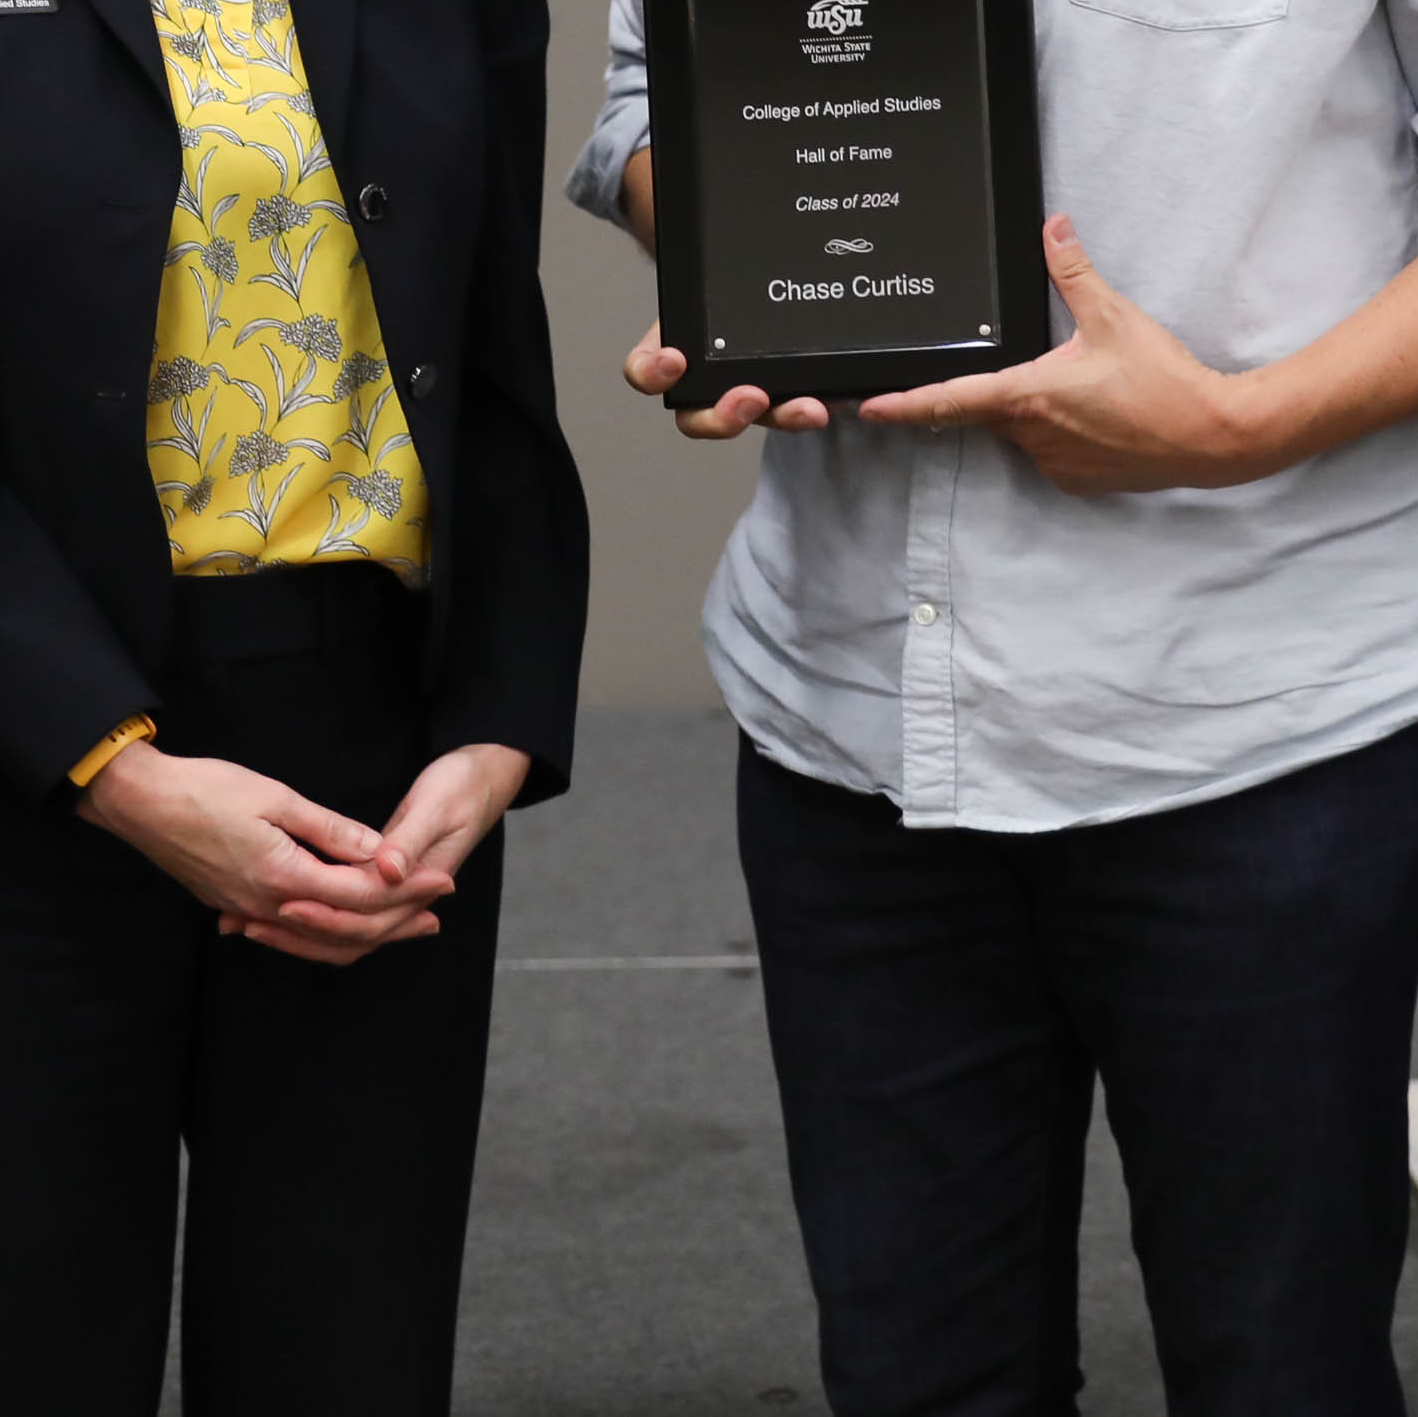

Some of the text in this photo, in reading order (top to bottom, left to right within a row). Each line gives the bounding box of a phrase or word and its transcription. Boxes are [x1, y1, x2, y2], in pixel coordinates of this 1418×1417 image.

[16, 0, 50, 8] Studies
[742, 95, 942, 121] College of Applied Studies
[795, 145, 892, 164] Hall of Fame
[795, 192, 900, 211] Class of 2024
[767, 274, 935, 302] Chase Curtiss
